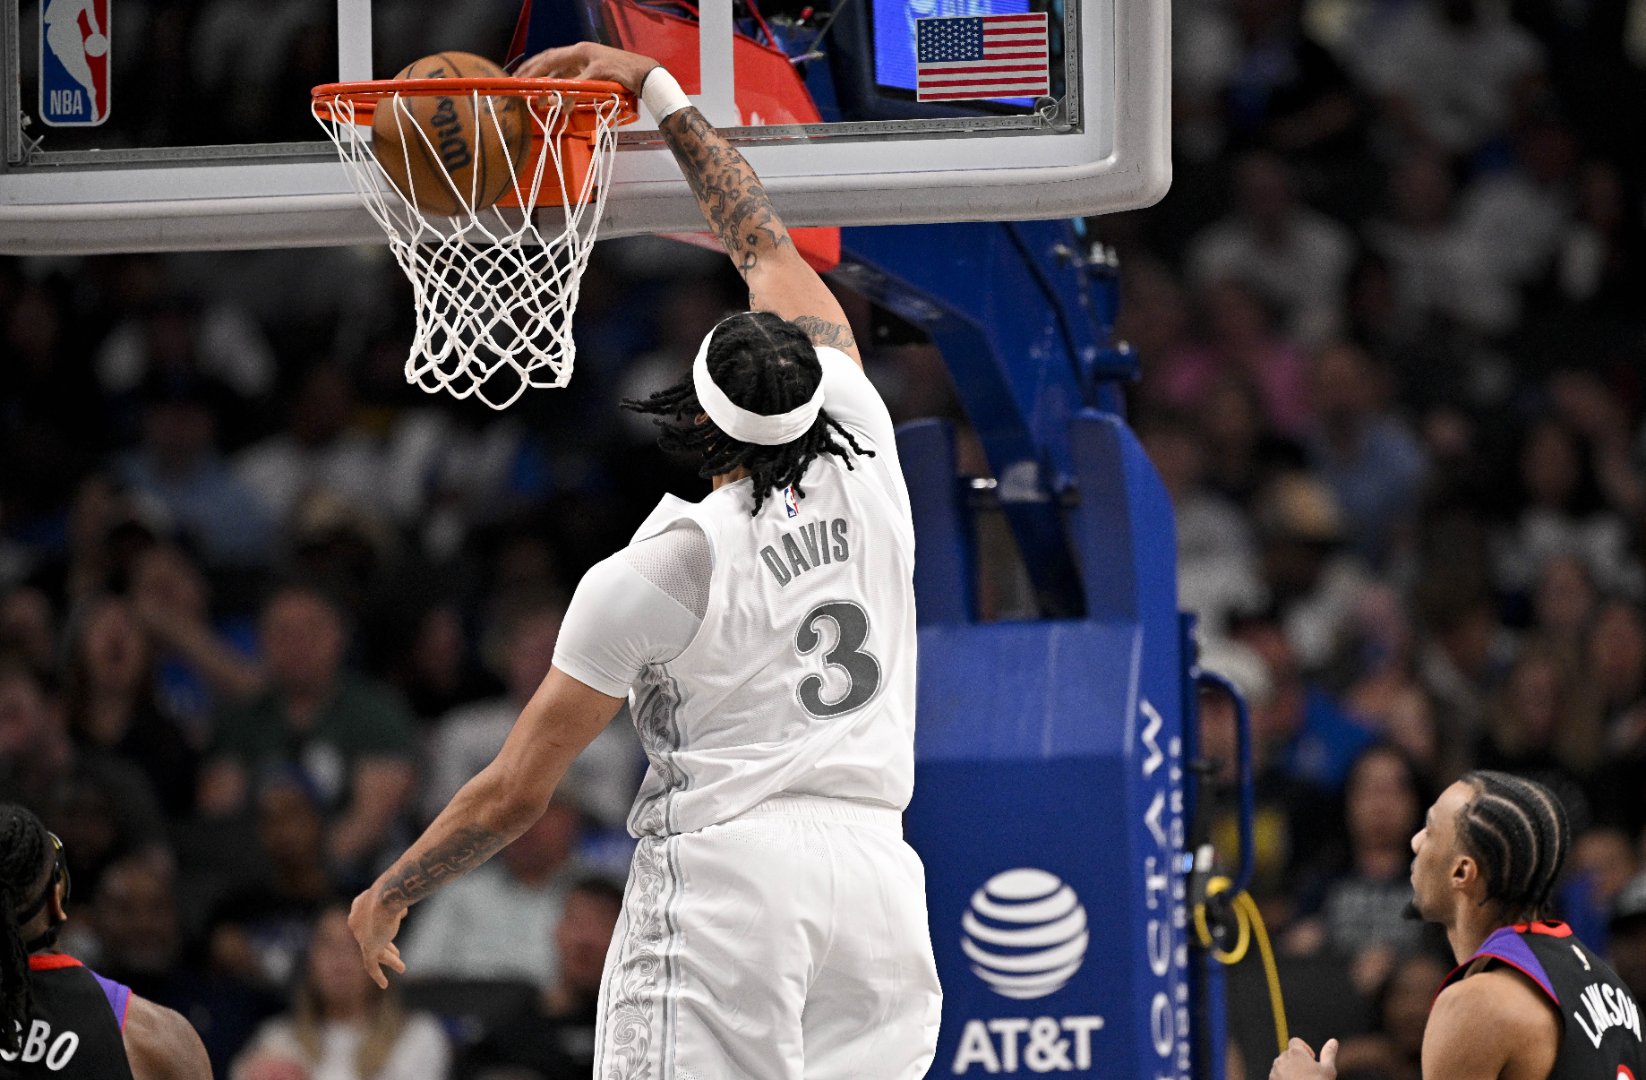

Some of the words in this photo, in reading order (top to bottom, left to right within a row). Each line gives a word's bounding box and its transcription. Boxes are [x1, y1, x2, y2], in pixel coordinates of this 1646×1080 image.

[50, 89, 83, 115] NBA
[429, 68, 472, 174] Wils
[760, 518, 850, 587] DAVIS
[794, 599, 882, 720] 3
[1139, 698, 1173, 1080] OCTAW
[952, 1015, 1104, 1074] AT&T
[1573, 982, 1642, 1049] LAWSON
